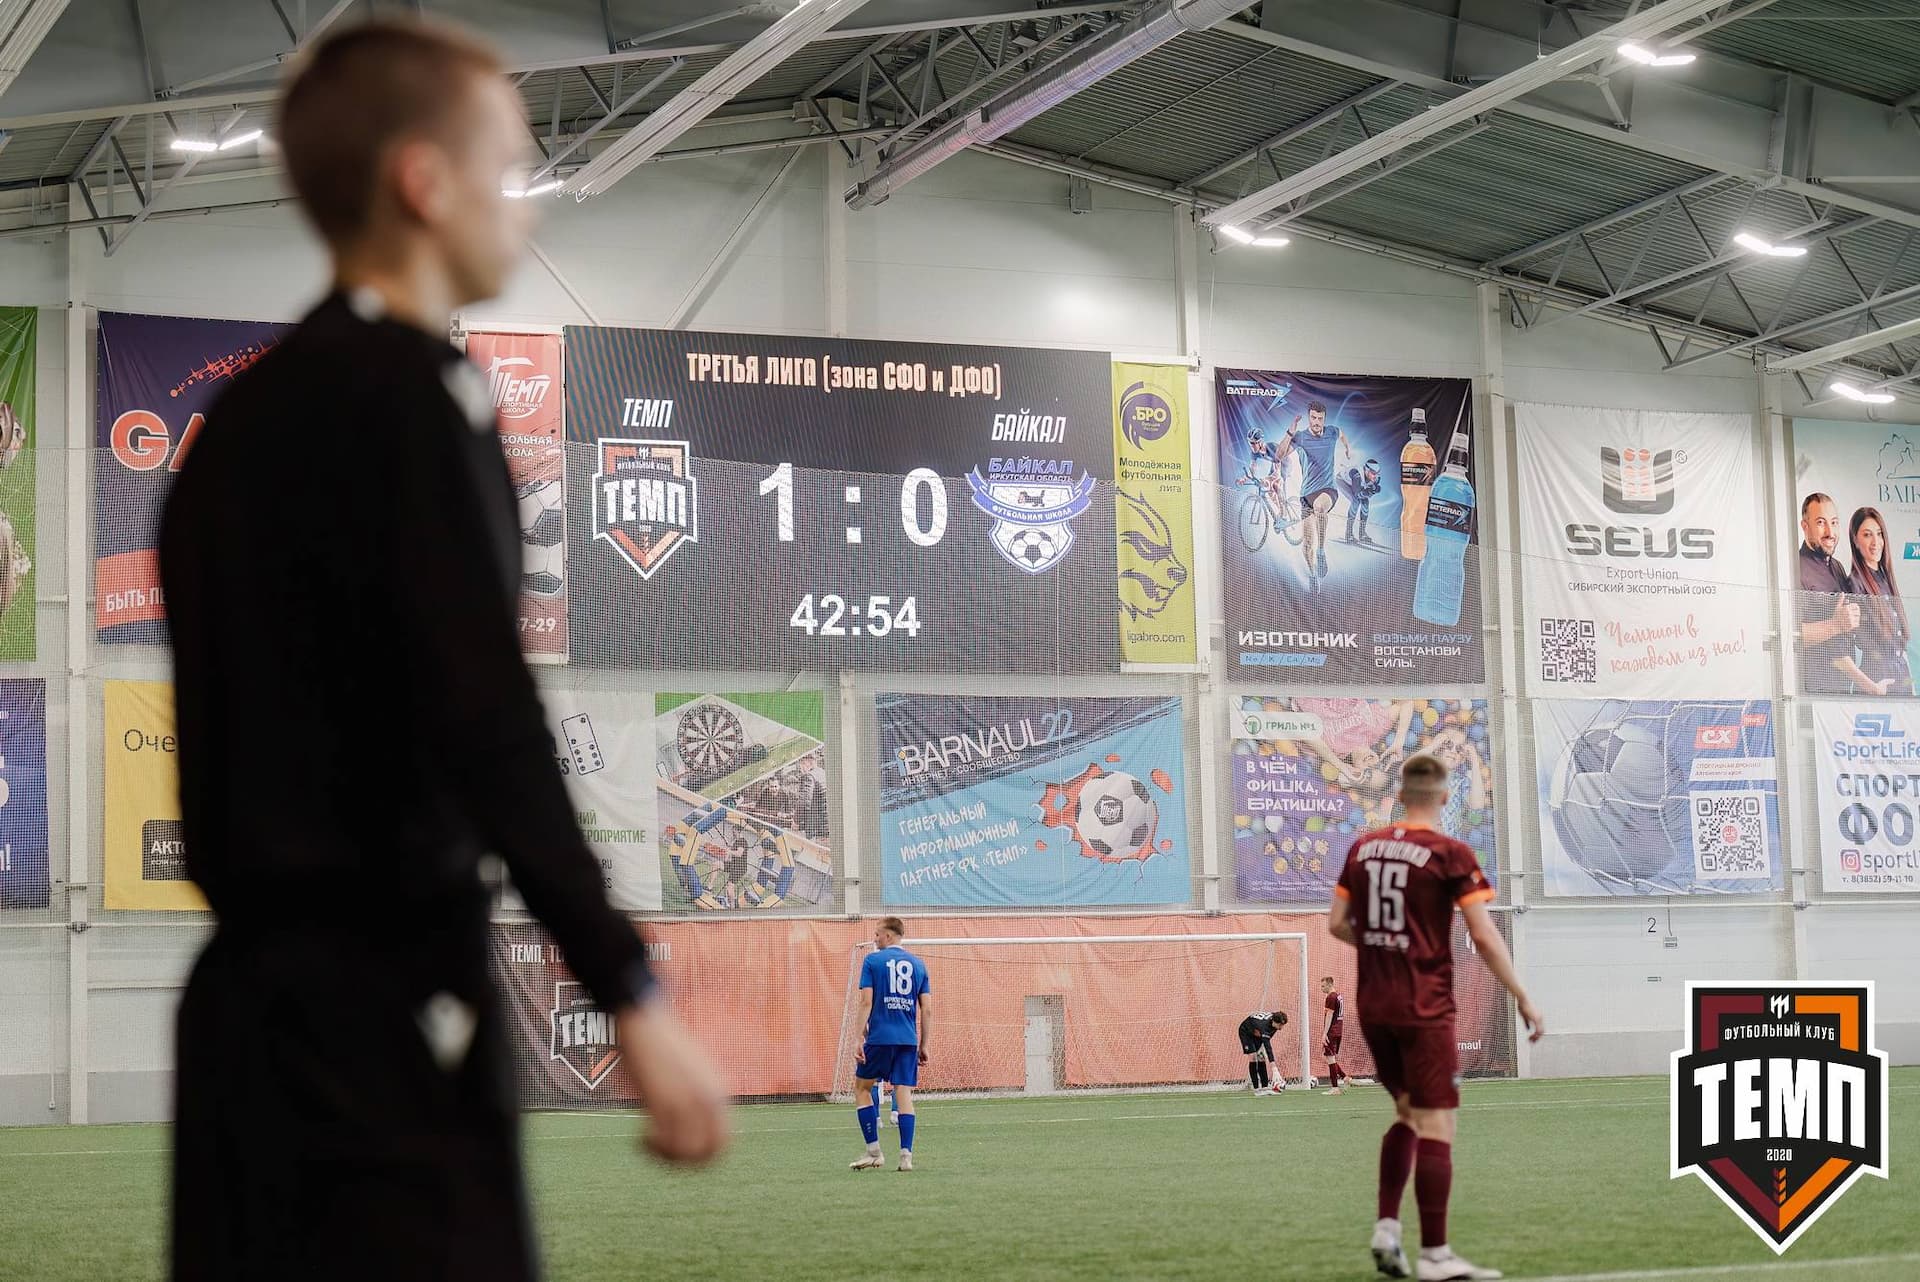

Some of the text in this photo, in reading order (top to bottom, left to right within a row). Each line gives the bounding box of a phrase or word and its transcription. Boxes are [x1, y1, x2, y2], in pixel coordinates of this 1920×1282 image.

[687, 353, 1001, 400] ТРЕТЬЯ ЛИГА (зона СФО и ДФО)
[622, 398, 674, 428] ТЕМП
[991, 408, 1067, 443] БАЙКАЛ
[110, 409, 206, 473] GA
[498, 434, 553, 445] БОЛЬНАЯ
[503, 447, 534, 457] КОЛА
[988, 455, 1074, 474] БАЙКАЛ
[1121, 468, 1182, 481] футбольная
[990, 473, 1035, 481] ИРКУТСКАЯ
[603, 478, 687, 527] ТЕМП
[759, 463, 794, 541] 1
[901, 467, 948, 546] 0
[1565, 523, 1715, 560] SEUS
[1568, 581, 1717, 595] СИБИРСКИЙ ЭКСПОРТНЫЙ СОЮЗ
[105, 588, 146, 613] БЫТЬ
[519, 618, 557, 632] 7-29
[790, 594, 921, 637] 42:54
[1238, 630, 1358, 648] ИЗОТОНИК
[1373, 633, 1428, 643] ВОЗЬМИ
[1374, 645, 1461, 656] ВОССТАНОВИ
[1375, 658, 1415, 668] СИЛЫ.
[1265, 721, 1298, 731] ГРИЛЬ
[1852, 713, 1905, 738] SL
[124, 729, 176, 753] Оче
[1246, 756, 1297, 774] В ЧЁМ
[1246, 780, 1318, 796] ФИШКА,
[1836, 773, 1920, 797] СПОРТ
[1247, 798, 1345, 812] БРАТИШКА?
[577, 809, 597, 825] НИЙ
[898, 799, 987, 836] ГЕНЕРАЛЬНЫЙ
[1838, 802, 1920, 847] ФО
[583, 829, 647, 843] ЕРОПРИЯТИЕ
[900, 817, 1020, 863] ИНФОРМАЦИОННЫЙ
[151, 840, 186, 855] АКТ
[900, 860, 955, 889] ПАРТНЕР
[957, 854, 980, 875] ФК
[1864, 850, 1920, 873] sportl
[1365, 860, 1409, 932] 15
[1647, 917, 1657, 933] 2
[511, 943, 546, 966] ТЕМП,
[643, 942, 671, 961] ЕМП!
[886, 959, 913, 995] 18
[1457, 1039, 1481, 1050] rnaul
